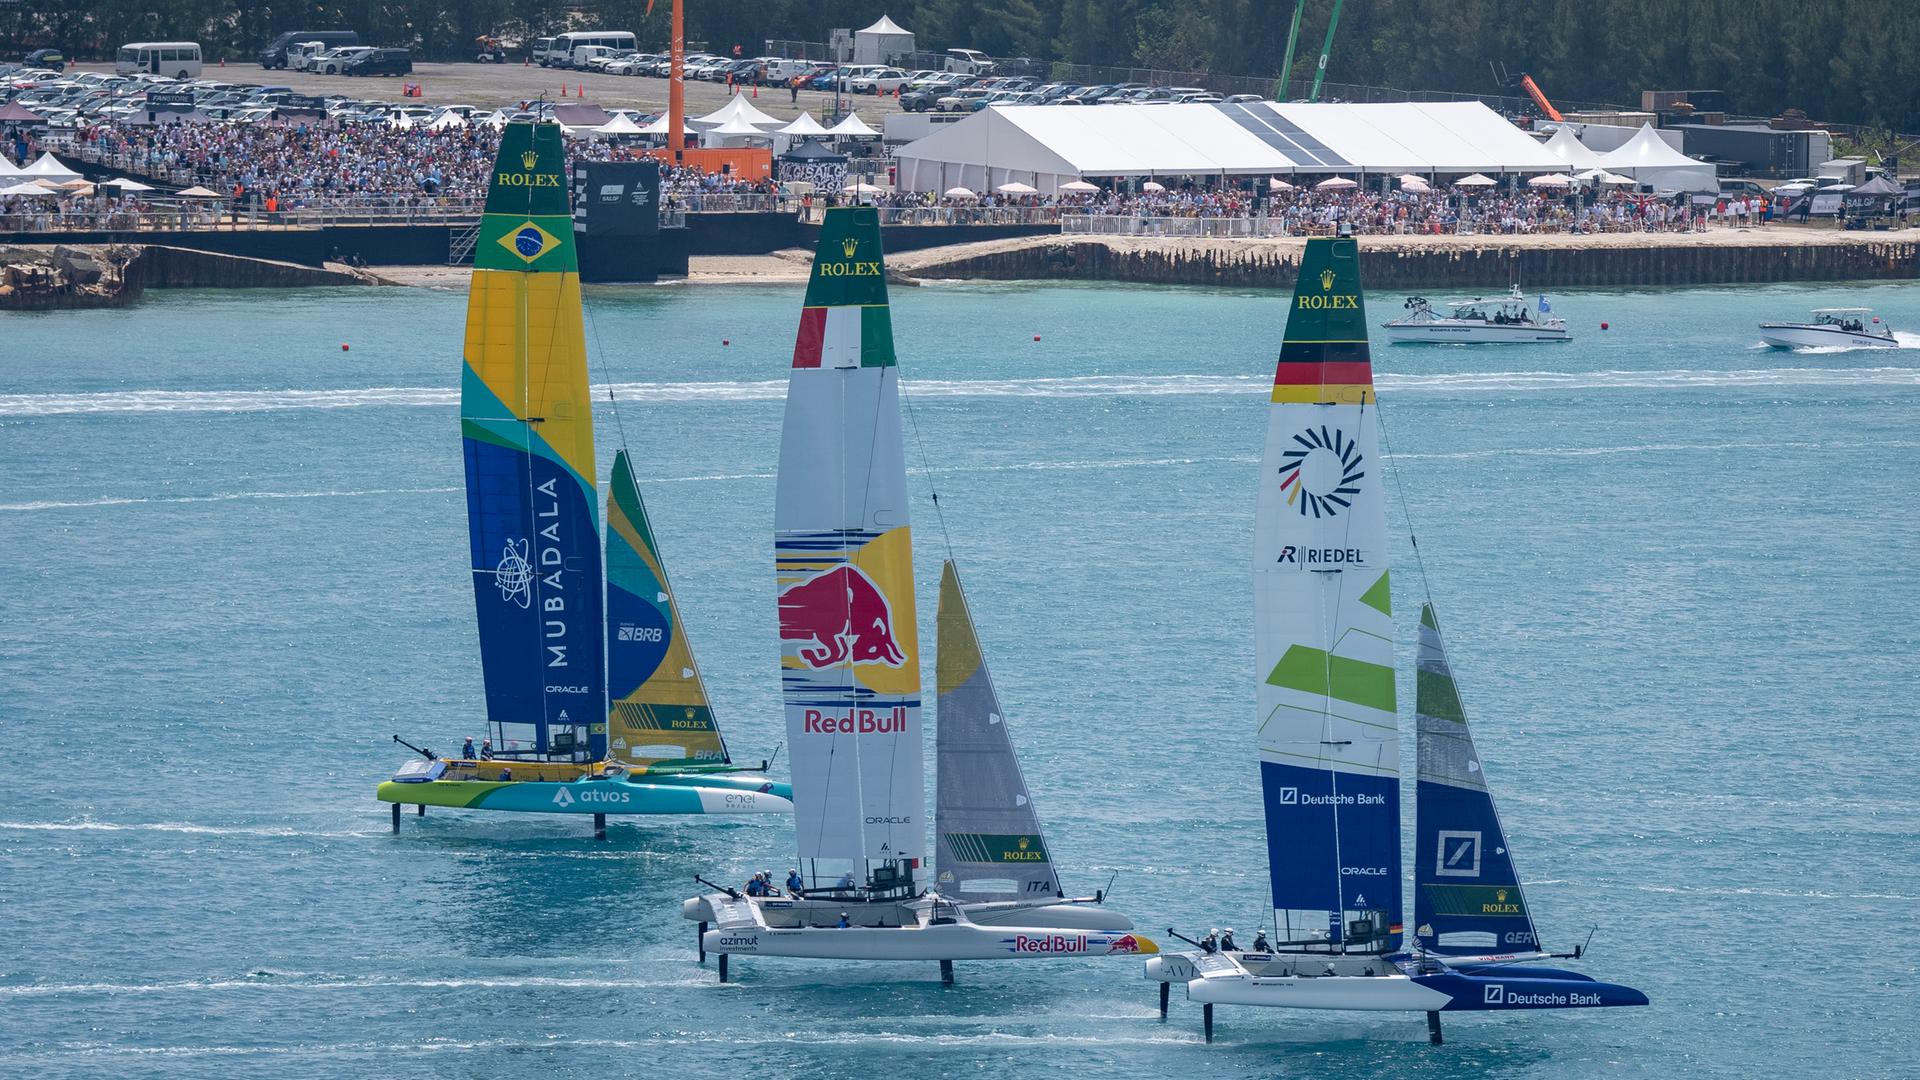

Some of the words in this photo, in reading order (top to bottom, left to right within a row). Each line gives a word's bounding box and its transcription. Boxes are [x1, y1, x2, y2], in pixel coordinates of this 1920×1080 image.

[498, 173, 560, 186] ROLEX
[820, 262, 881, 276] ROLEX
[1297, 295, 1359, 309] ROLEX
[1308, 548, 1364, 563] RIEDEL
[536, 477, 568, 668] MUBADALA
[633, 627, 662, 642] BRB
[545, 685, 589, 693] ORACLE
[671, 720, 708, 729] ROLEX
[804, 708, 855, 733] Red
[858, 706, 906, 733] Bull
[694, 750, 722, 760] BRA
[580, 788, 630, 803] atvos
[725, 793, 755, 804] enel
[1301, 794, 1355, 805] Deutsche
[1357, 793, 1385, 805] Bank
[865, 816, 911, 824] ORACLE
[1003, 851, 1042, 860] ROLEX
[1341, 867, 1388, 876] ORACLE
[1026, 880, 1051, 892] ITA
[1482, 903, 1519, 913] ROLEX
[719, 932, 758, 946] azimut
[1016, 935, 1051, 952] Red
[1053, 935, 1087, 952] Bull
[1504, 931, 1534, 944] GER
[1507, 992, 1567, 1005] Deutsche
[1569, 991, 1601, 1005] Bank
